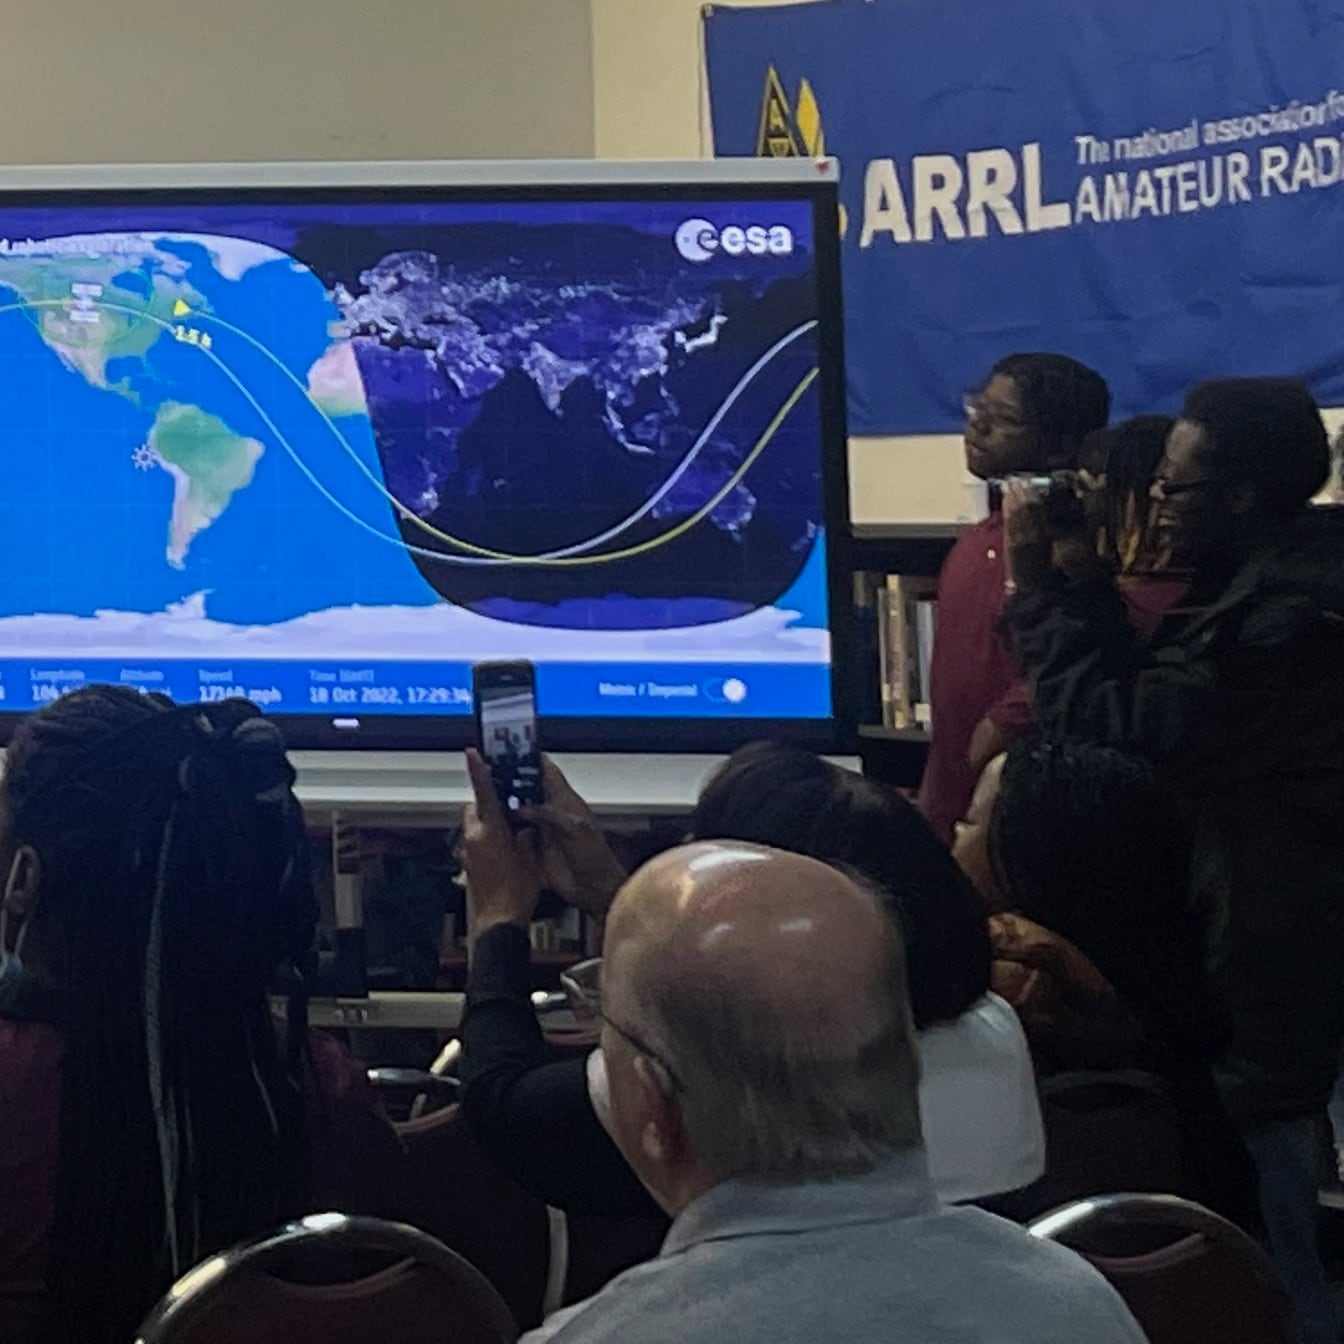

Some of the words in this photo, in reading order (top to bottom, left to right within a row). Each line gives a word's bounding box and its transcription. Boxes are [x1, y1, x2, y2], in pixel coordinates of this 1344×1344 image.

[1114, 118, 1199, 160] national
[1203, 99, 1325, 145] association
[859, 141, 1072, 248] ARRL
[1075, 152, 1252, 224] AMATEUR
[720, 224, 793, 255] esa
